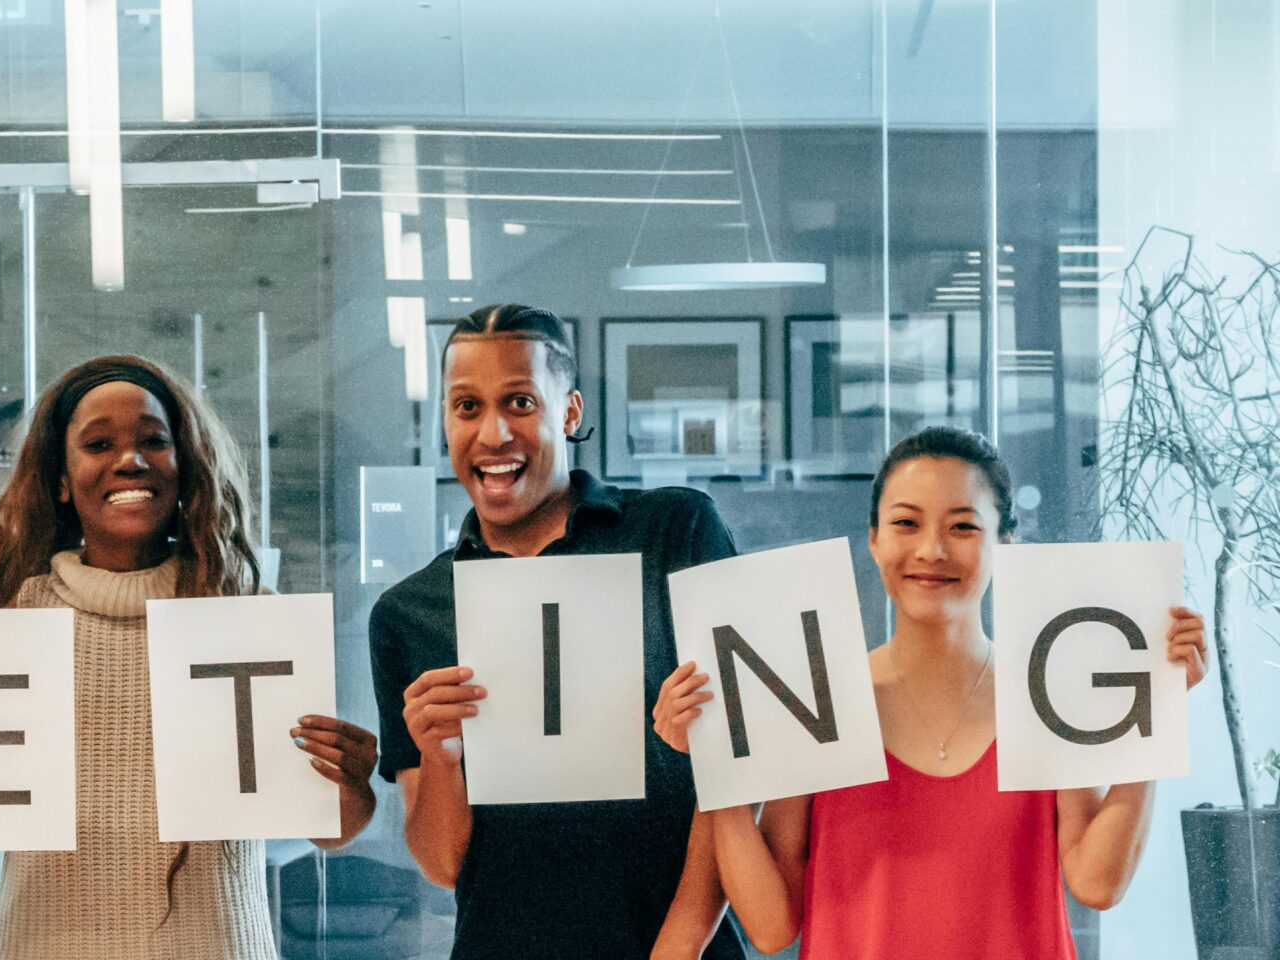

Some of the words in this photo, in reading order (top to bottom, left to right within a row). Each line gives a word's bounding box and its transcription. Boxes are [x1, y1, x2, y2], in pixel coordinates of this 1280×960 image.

[190, 661, 293, 793] T
[542, 603, 561, 736] I
[712, 610, 839, 758] N
[1028, 607, 1152, 745] G
